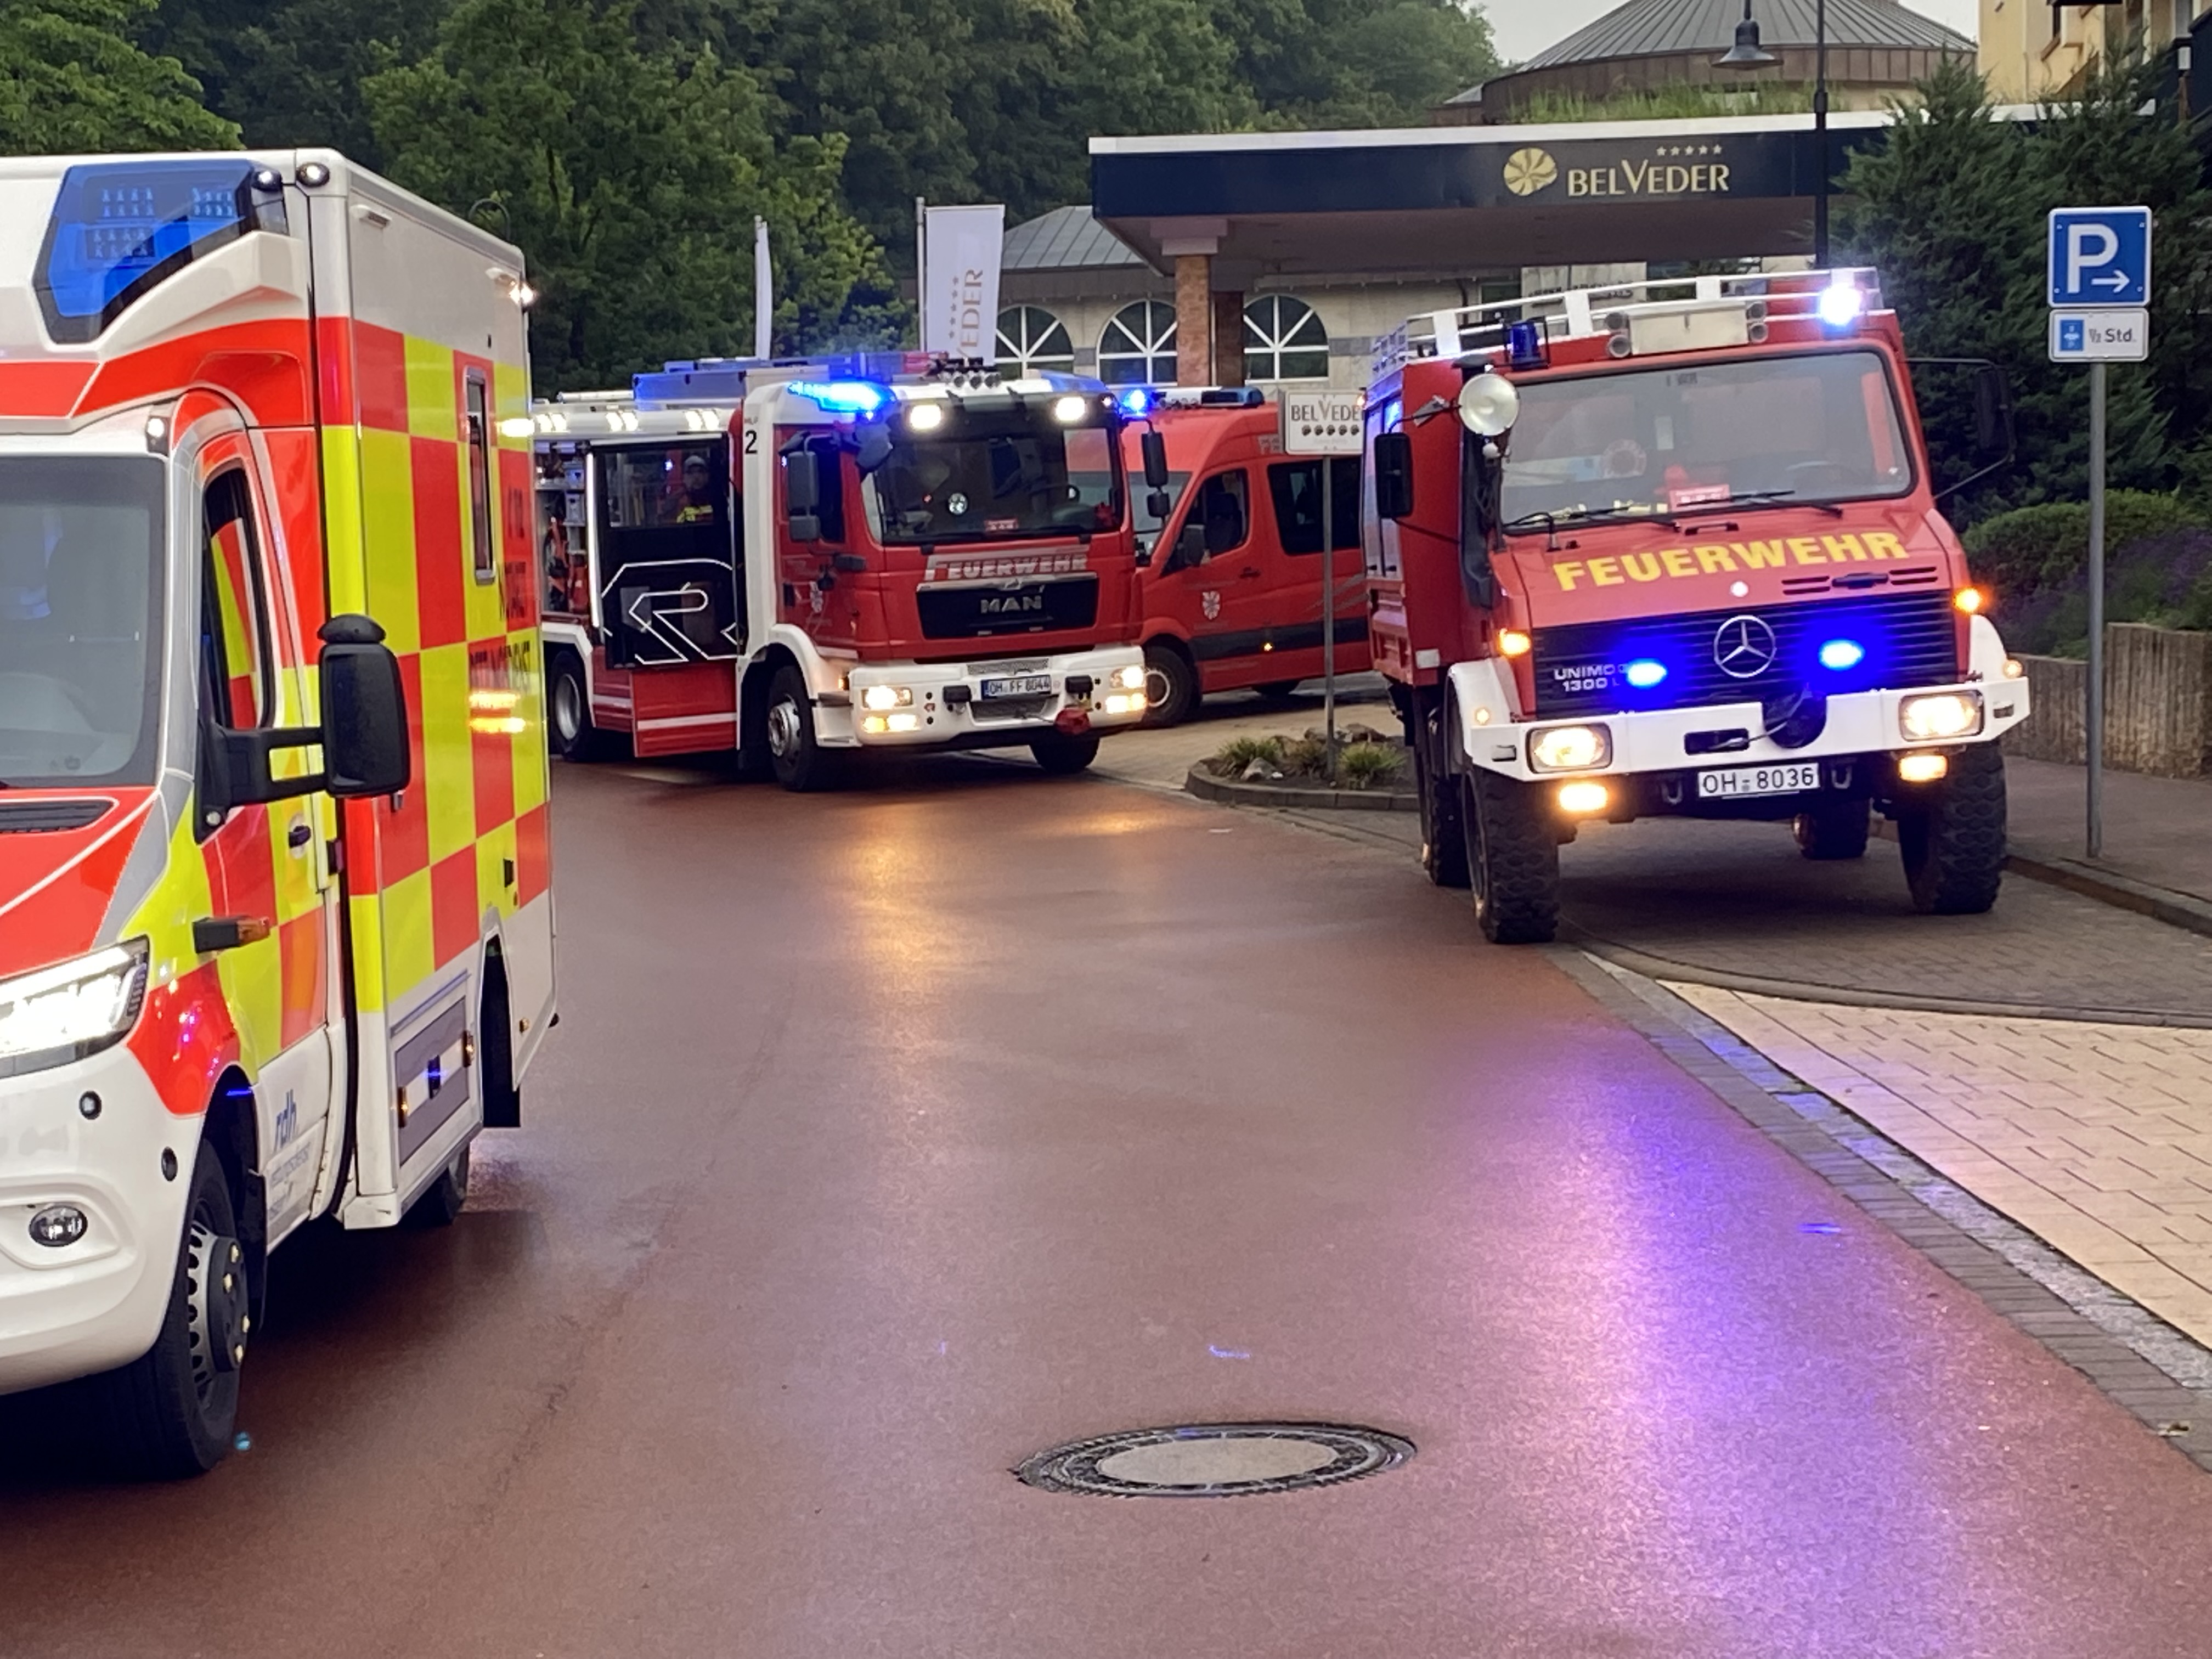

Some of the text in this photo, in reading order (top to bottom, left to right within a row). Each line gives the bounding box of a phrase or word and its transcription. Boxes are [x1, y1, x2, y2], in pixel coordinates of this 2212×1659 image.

[1568, 159, 1729, 196] BELVEDER
[2067, 223, 2119, 294] P
[746, 430, 758, 454] 2
[924, 546, 1088, 580] FEUERWEHR
[1553, 532, 1910, 591] FEUERWEHR
[980, 595, 1042, 613] MAN
[1562, 678, 1607, 692] 1300
